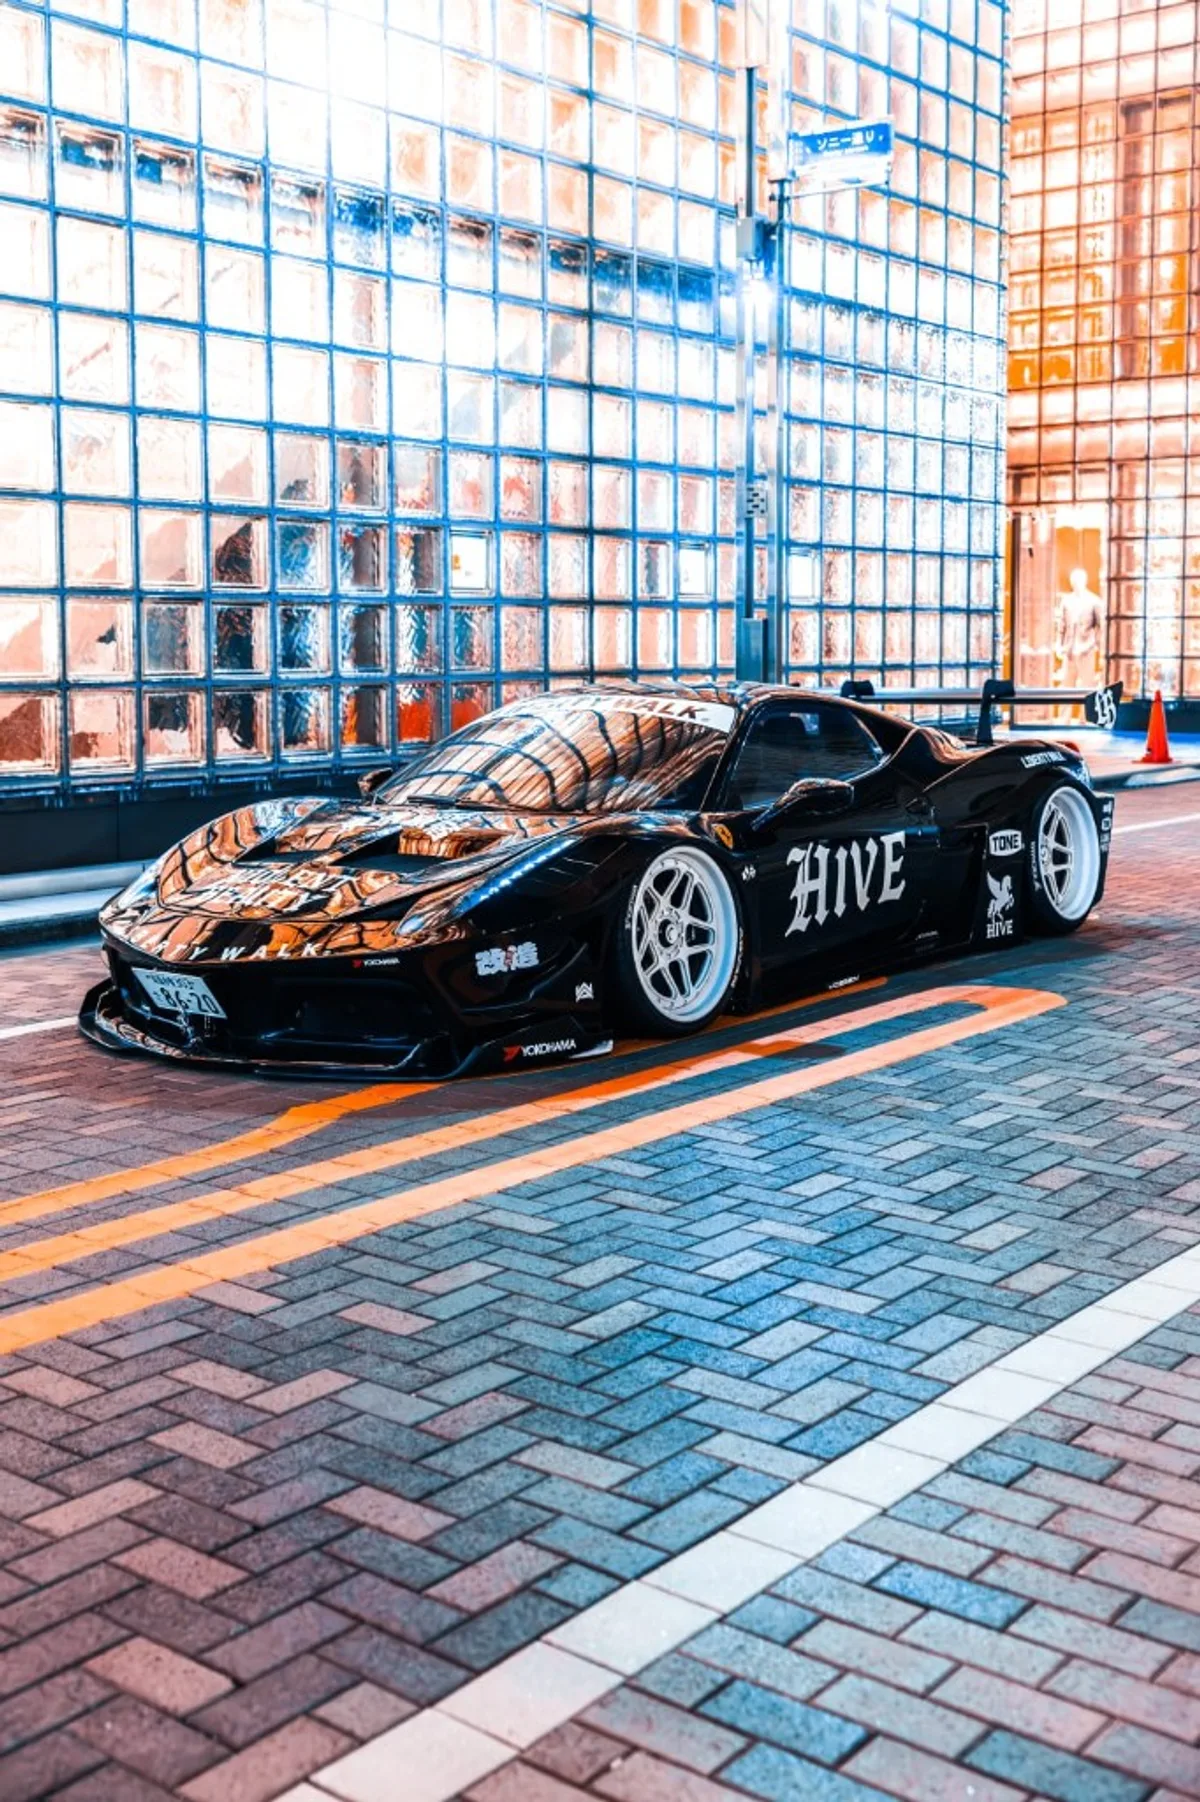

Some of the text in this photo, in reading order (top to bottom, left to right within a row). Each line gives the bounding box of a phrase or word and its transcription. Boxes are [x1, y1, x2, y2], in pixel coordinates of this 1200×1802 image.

[991, 832, 1021, 854] TONE
[784, 830, 906, 938] HIVE
[986, 919, 1014, 939] HIVE
[520, 1038, 577, 1057] YOKOHAMA
